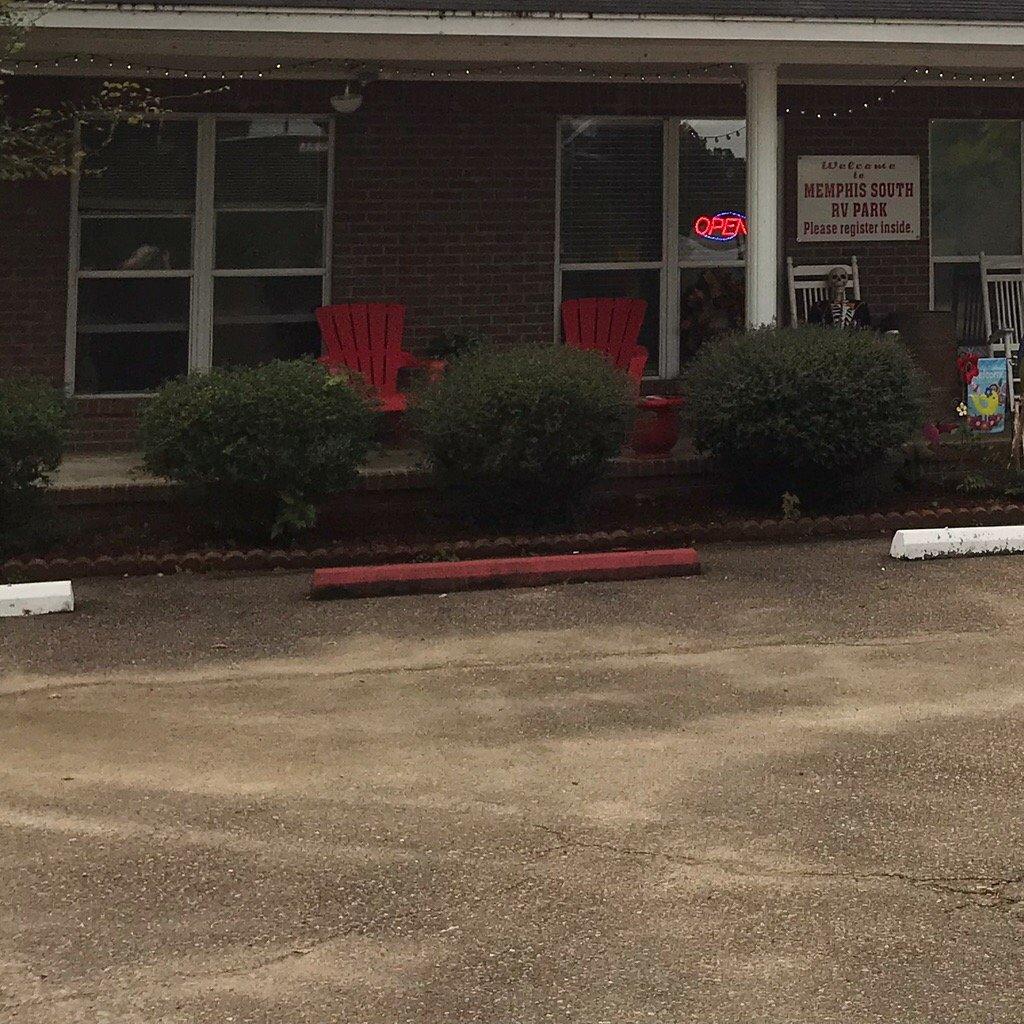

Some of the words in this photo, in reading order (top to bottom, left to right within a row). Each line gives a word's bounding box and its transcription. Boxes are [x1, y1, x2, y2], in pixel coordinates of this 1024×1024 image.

[821, 161, 896, 170] Welcome
[853, 171, 864, 179] to
[804, 182, 867, 198] MEMPHIS
[870, 182, 914, 197] SOUTH
[831, 202, 849, 218] RV
[853, 202, 888, 217] PARK
[803, 221, 838, 235] Please
[840, 221, 878, 237] register
[880, 220, 914, 234] inside.
